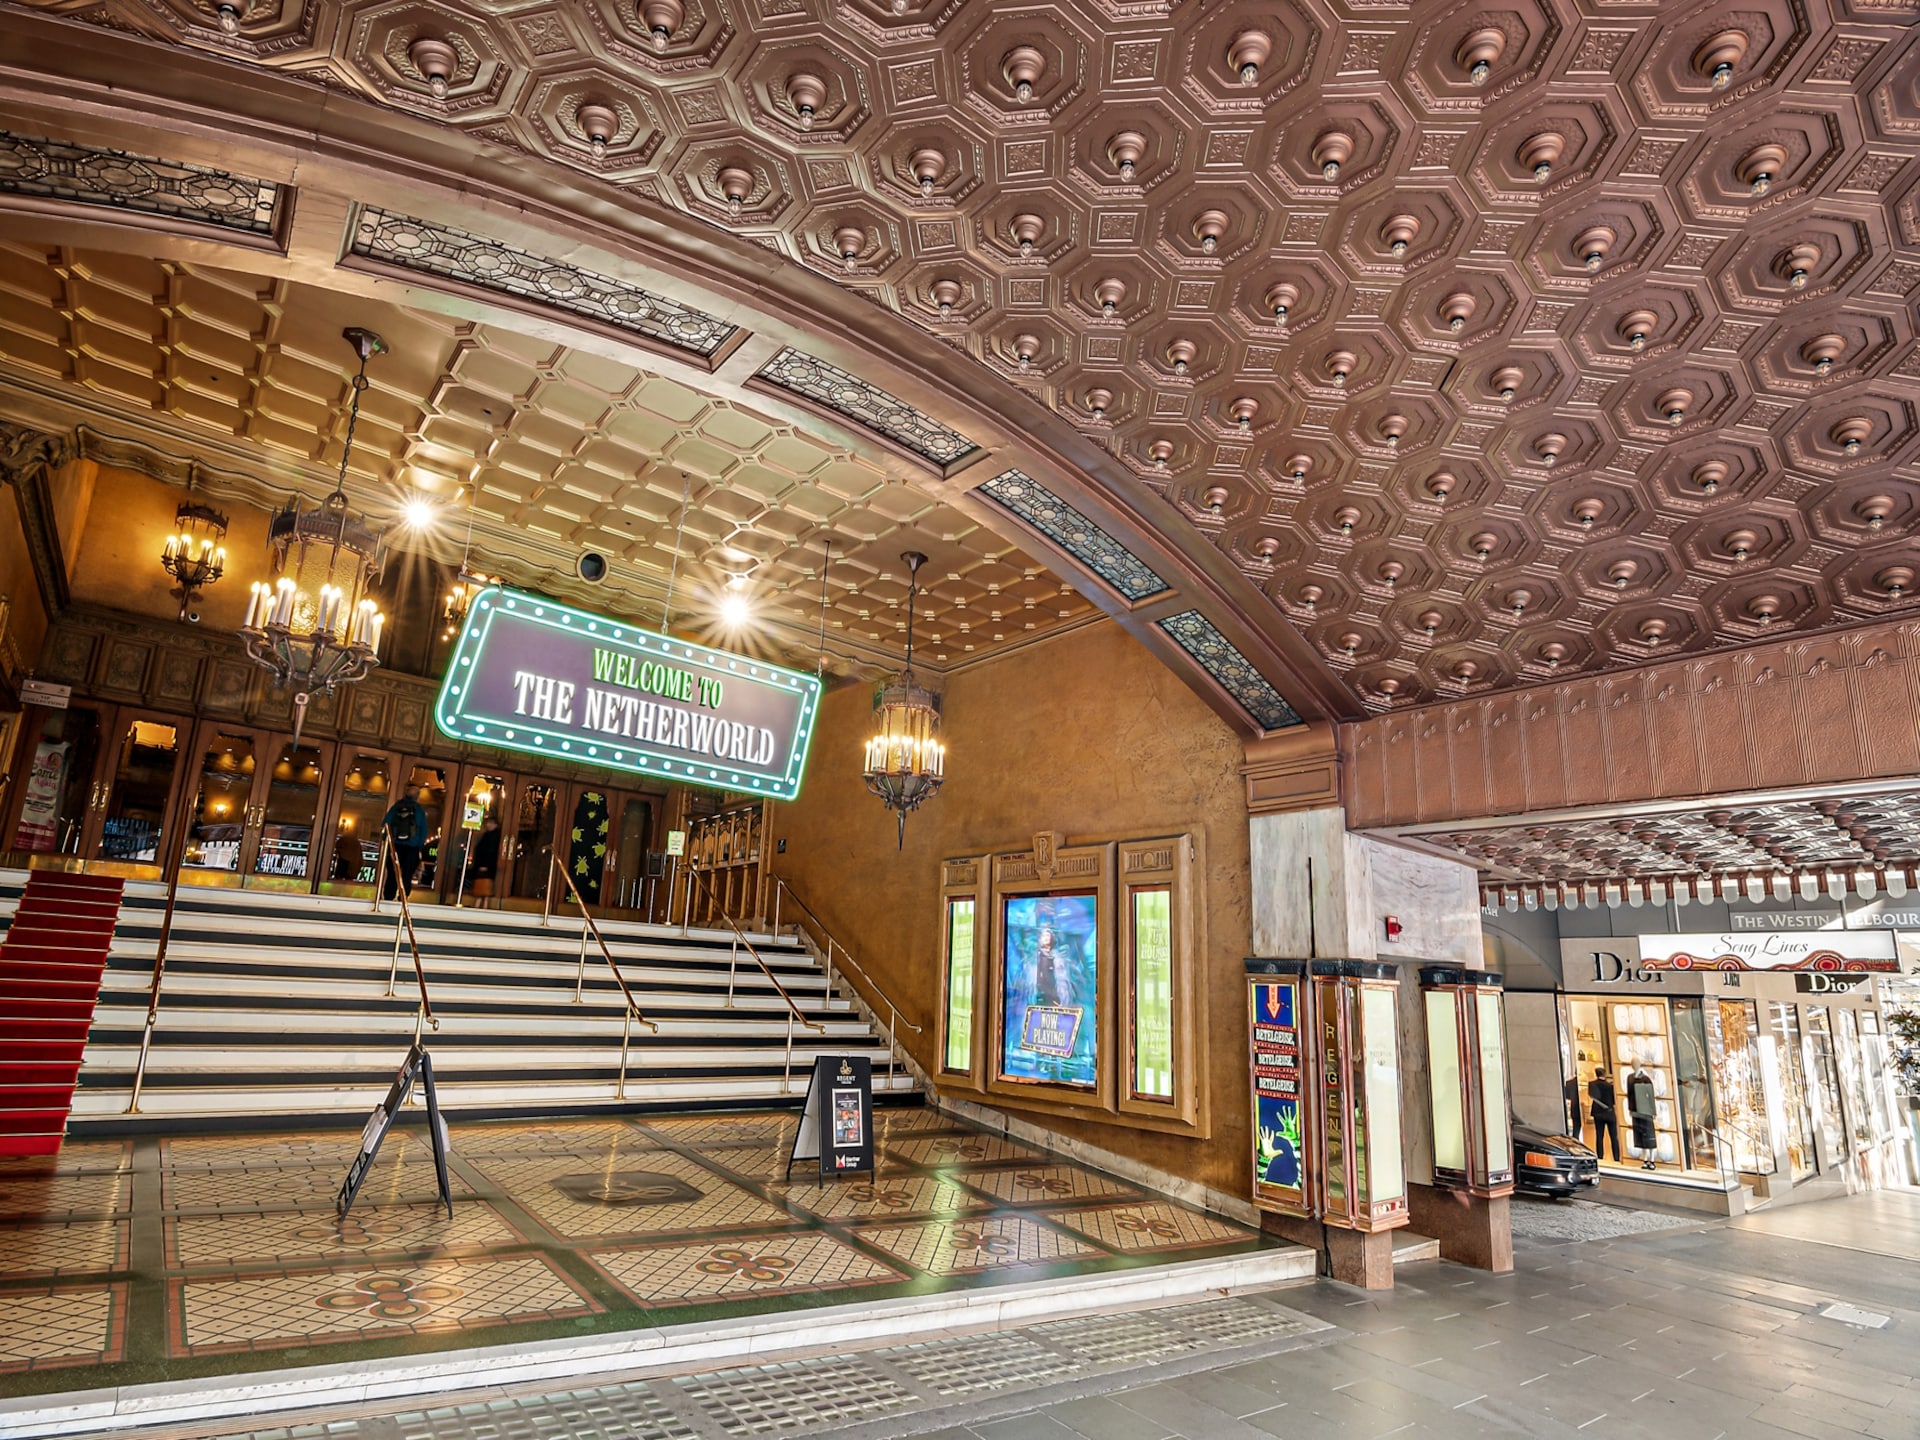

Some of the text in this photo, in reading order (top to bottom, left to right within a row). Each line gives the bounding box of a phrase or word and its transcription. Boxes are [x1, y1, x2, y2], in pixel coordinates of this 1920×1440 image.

[593, 647, 725, 709] WELCOME TO
[514, 670, 776, 767] THE NETHERWORLD
[1735, 915, 1765, 928] THE
[1768, 914, 1830, 928] WESTIN
[1808, 973, 1857, 993] Dior
[1041, 1012, 1059, 1030] NOW
[1033, 1028, 1066, 1047] PLAYING!
[1258, 1077, 1296, 1093] BETELGEUSE
[1325, 1025, 1339, 1155] REGENT
